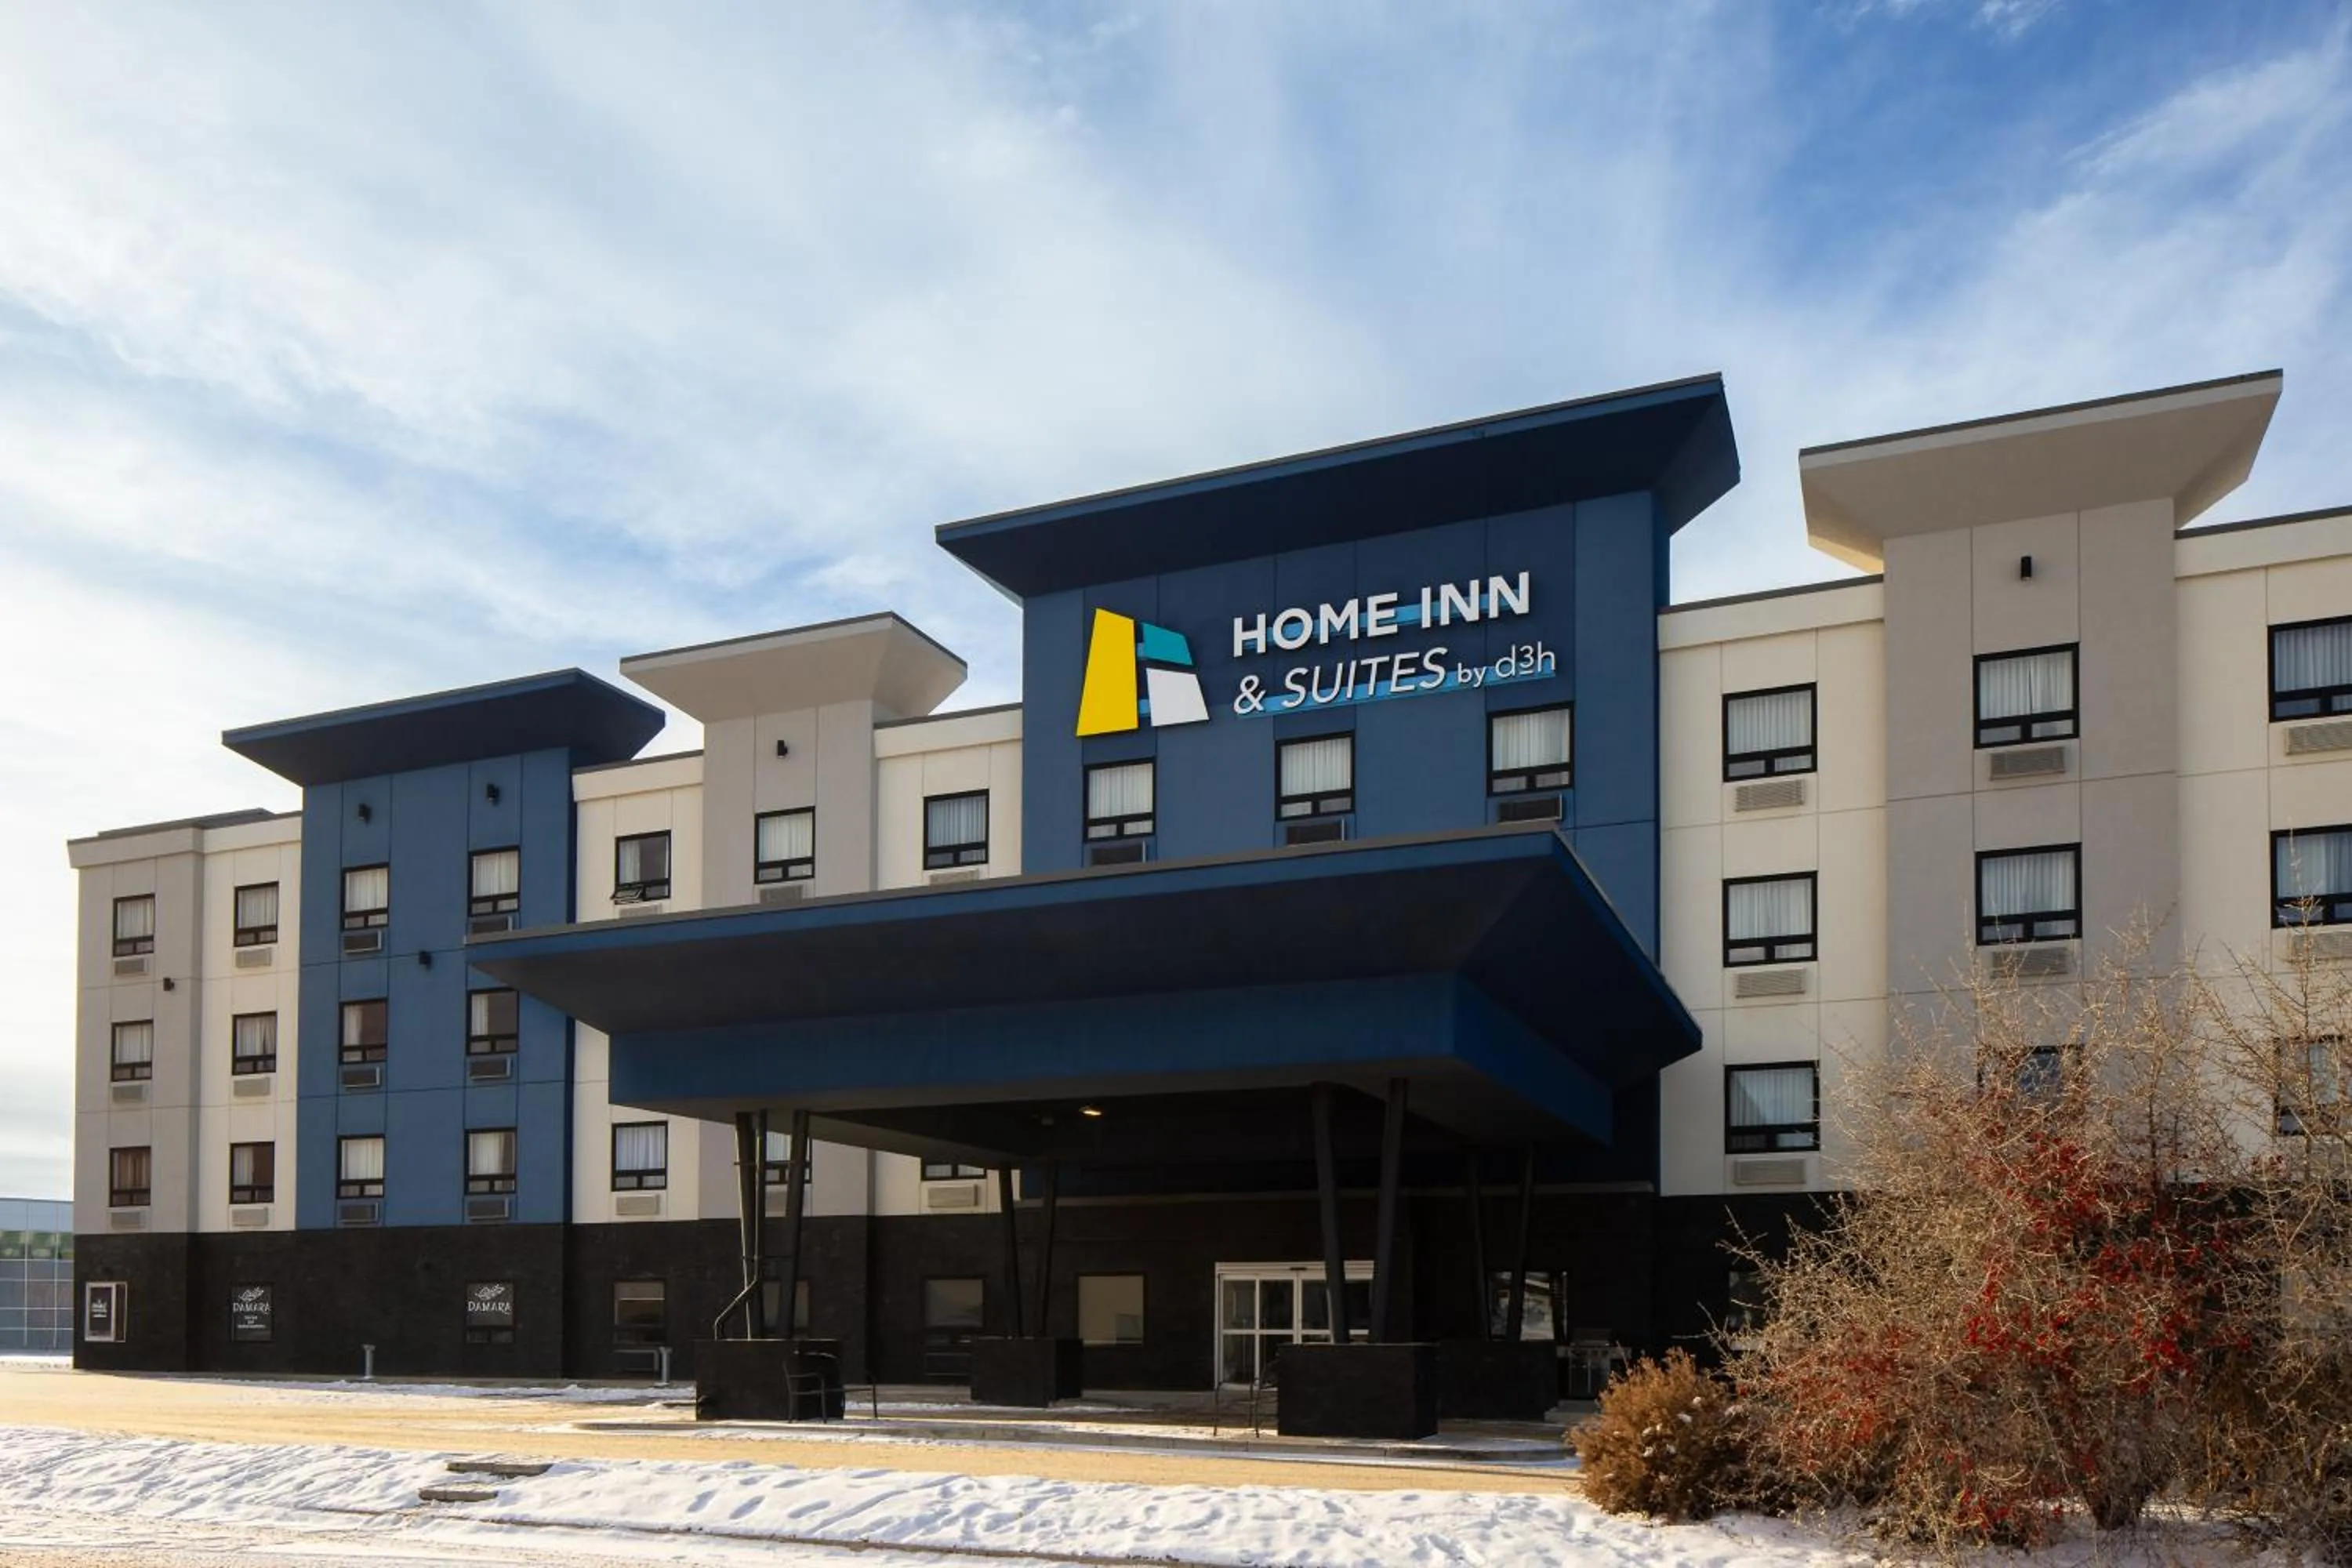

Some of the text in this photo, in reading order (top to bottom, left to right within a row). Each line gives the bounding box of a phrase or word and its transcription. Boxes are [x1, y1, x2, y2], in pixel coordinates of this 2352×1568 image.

[1232, 571, 1530, 658] HOME INN
[1232, 641, 1556, 714] & SUITES by d3h
[233, 1301, 271, 1315] DAMARA
[467, 1300, 511, 1315] DAMARA
